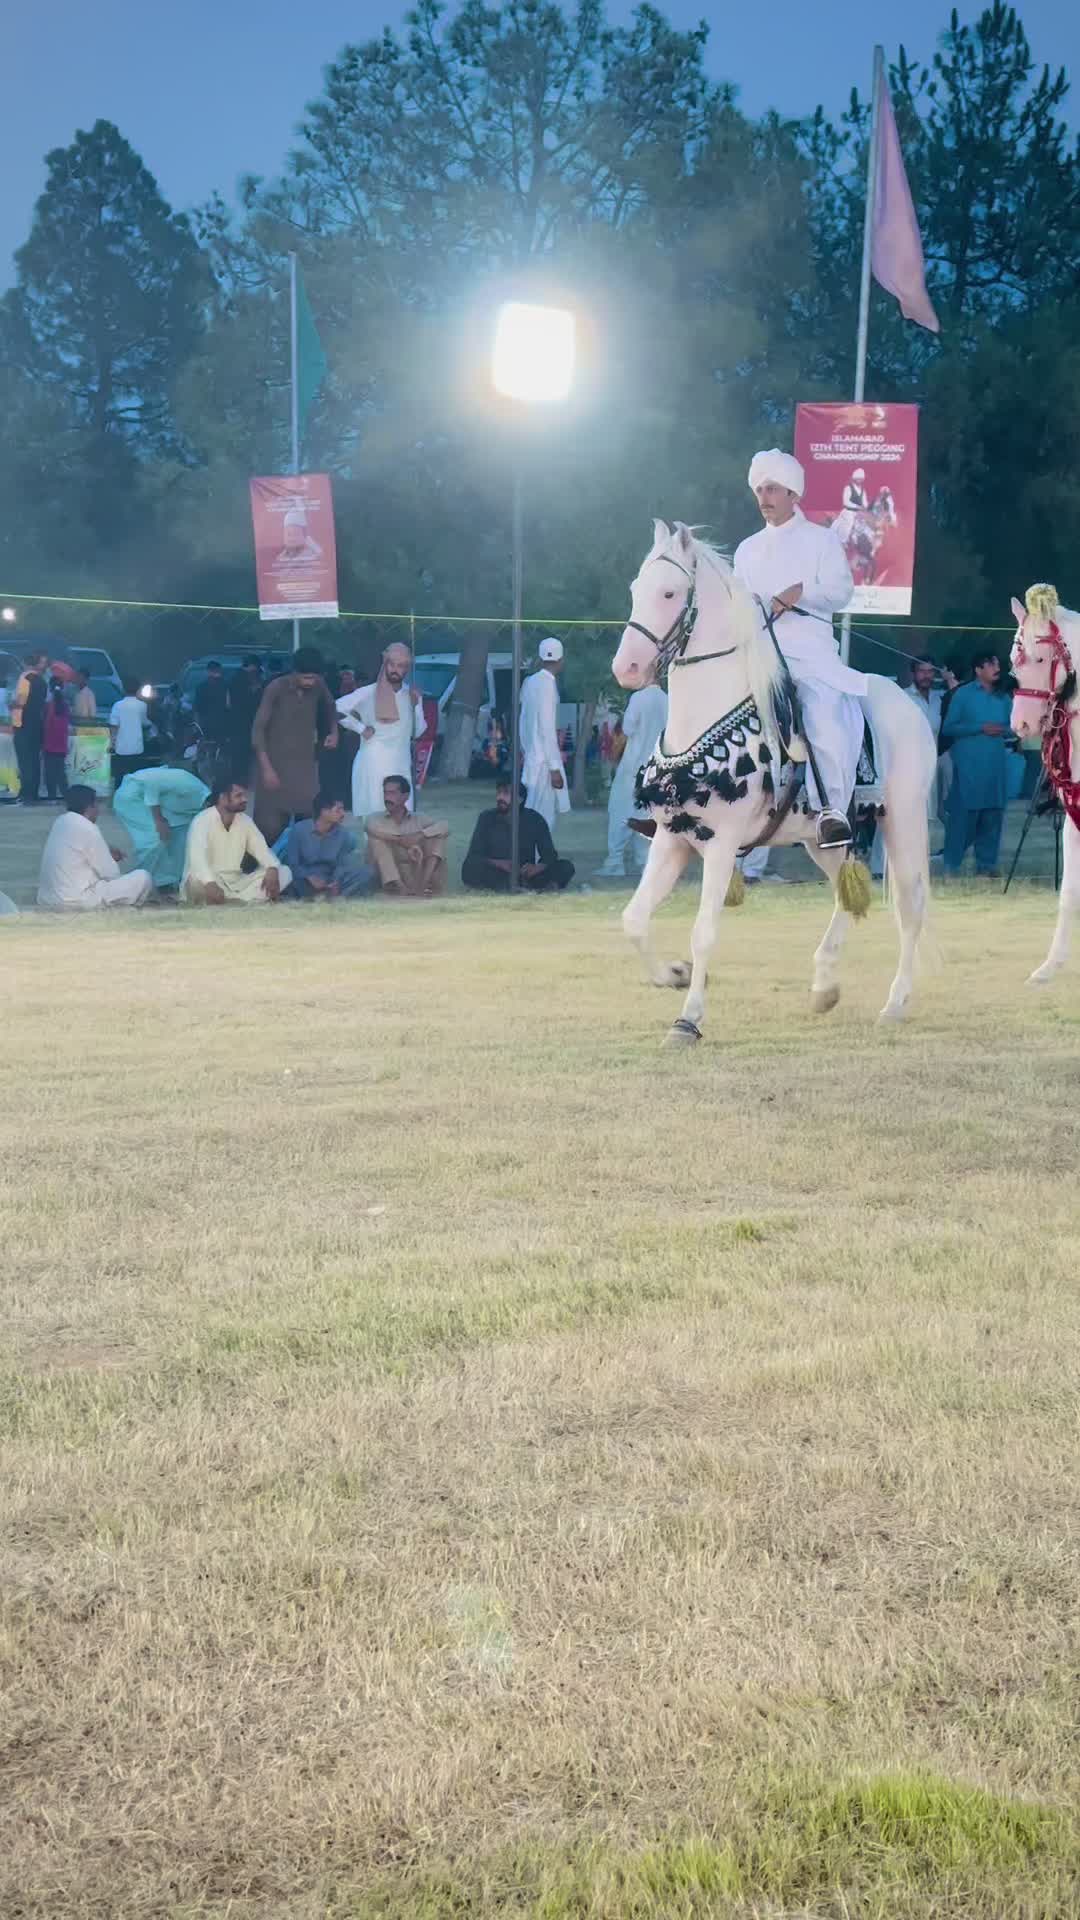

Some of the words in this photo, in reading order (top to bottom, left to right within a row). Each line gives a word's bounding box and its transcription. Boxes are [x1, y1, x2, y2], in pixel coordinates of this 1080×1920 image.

[810, 443, 832, 452] 12TH
[834, 444, 858, 452] TENT
[861, 444, 905, 452] PEGGING
[813, 452, 879, 460] CHAMPIONSHIP
